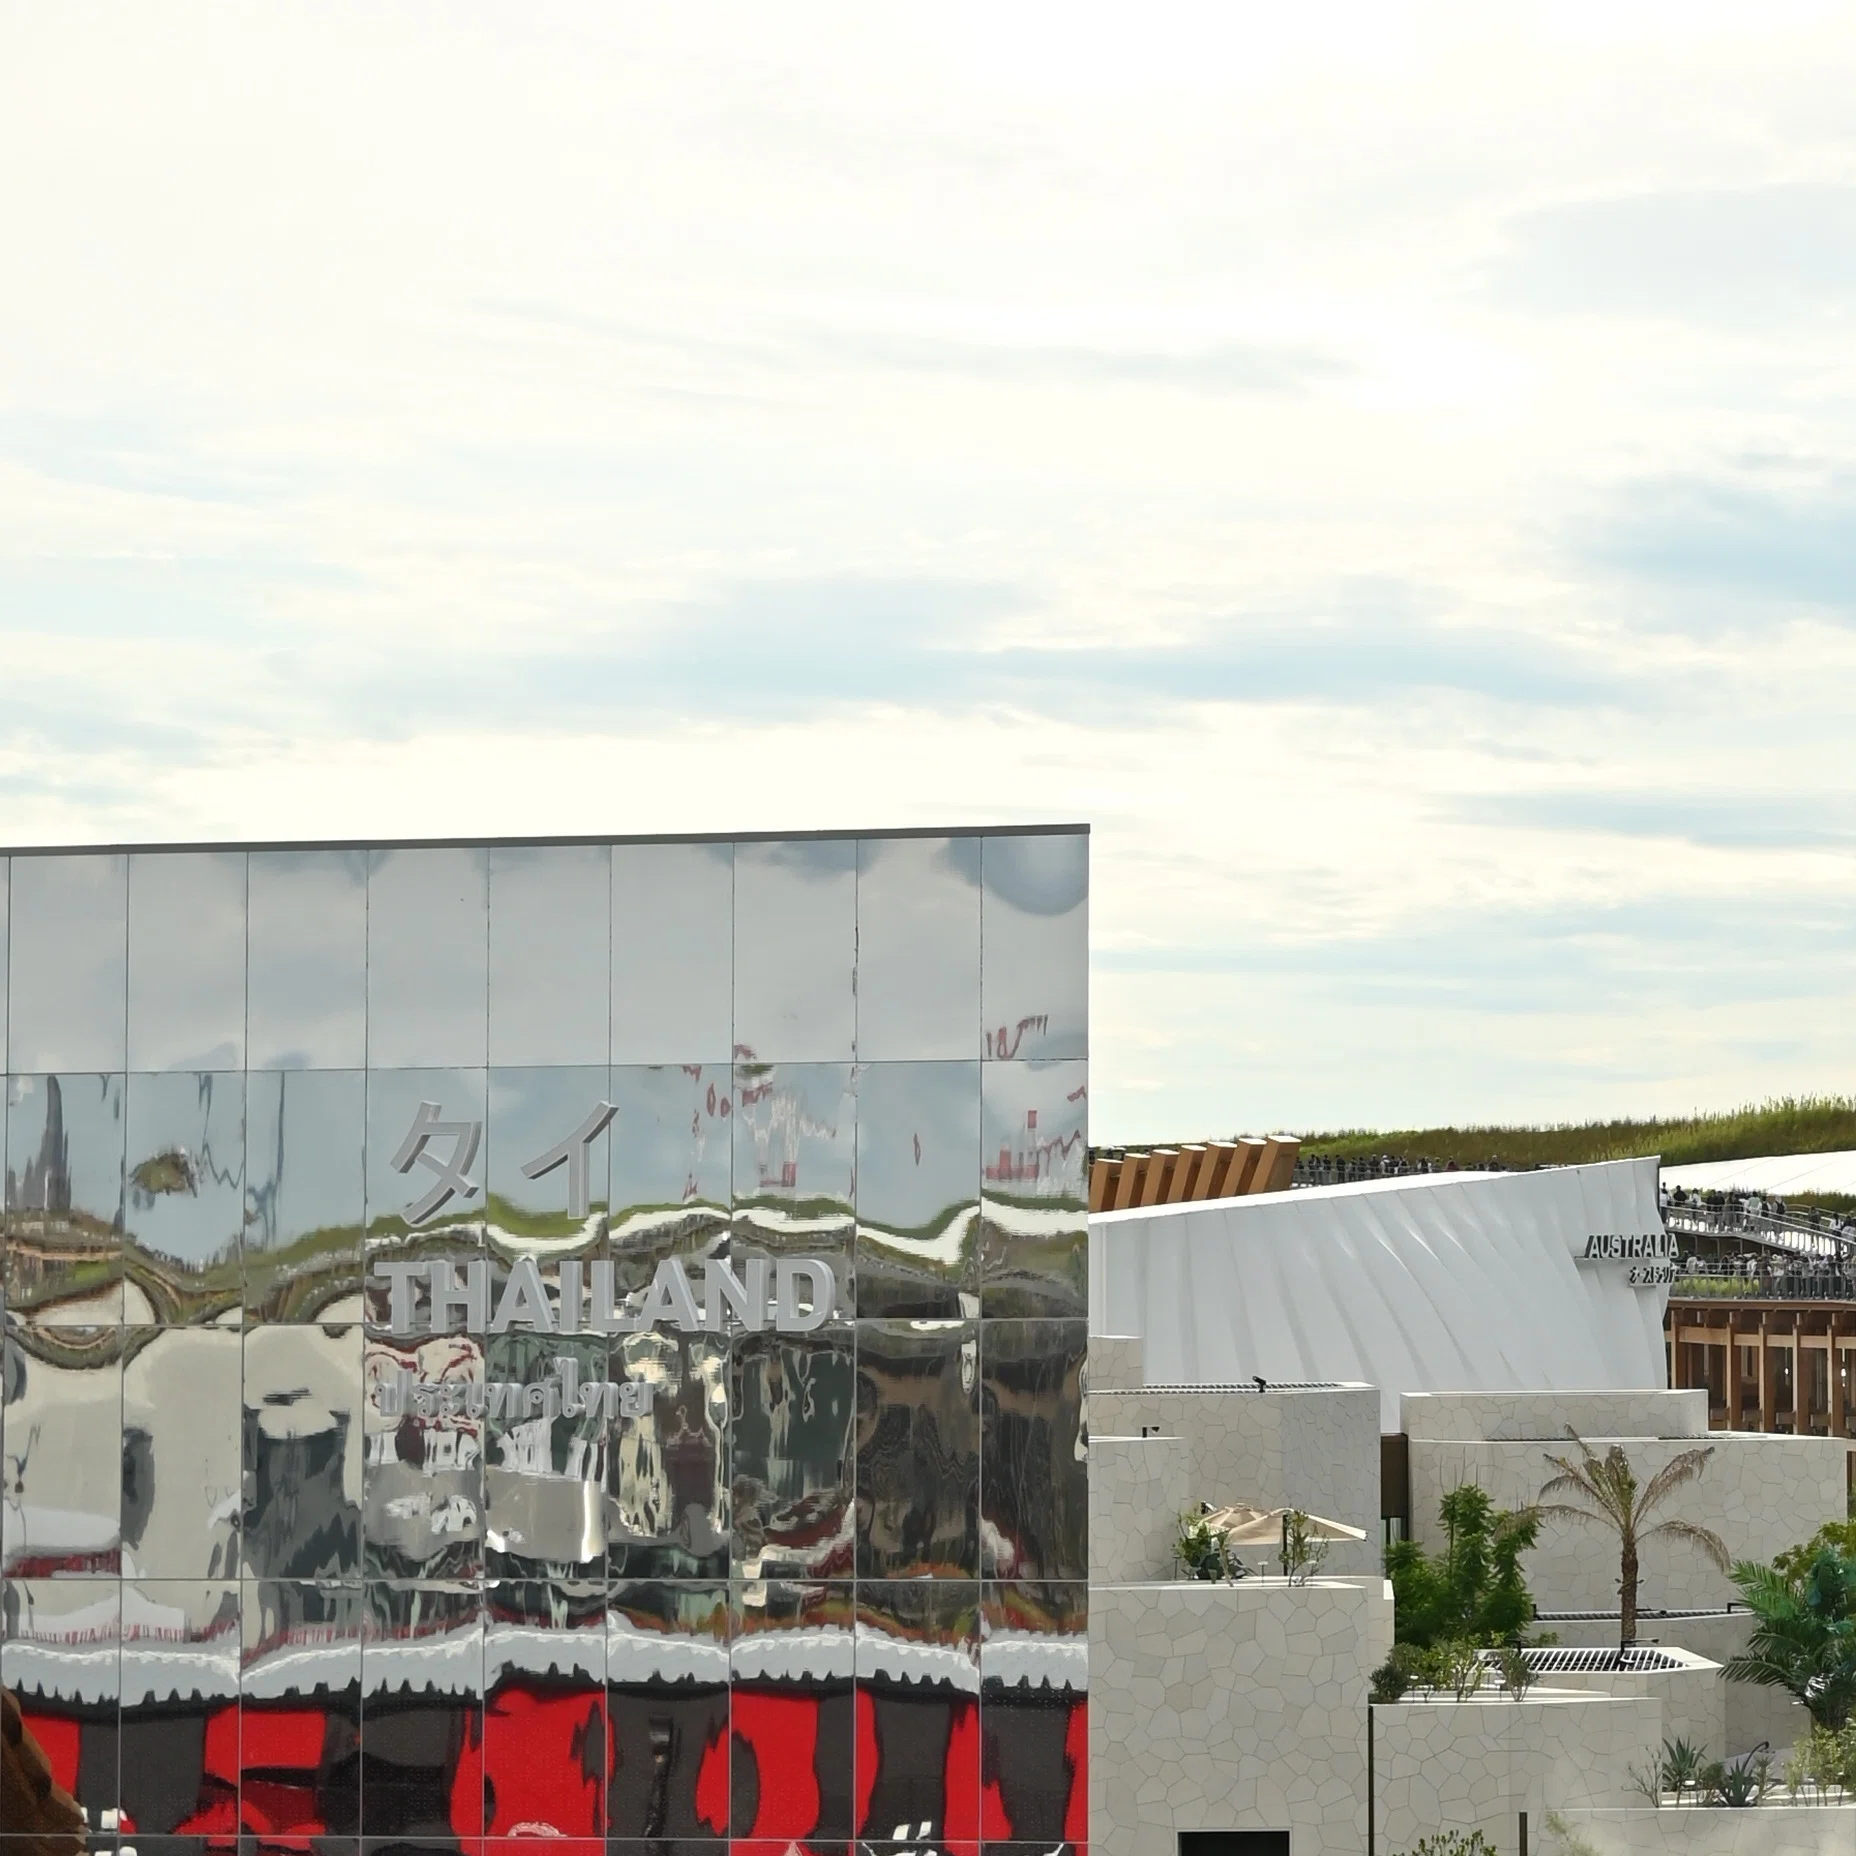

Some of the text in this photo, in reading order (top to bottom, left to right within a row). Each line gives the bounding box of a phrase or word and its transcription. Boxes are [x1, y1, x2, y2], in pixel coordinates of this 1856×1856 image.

[390, 1100, 619, 1227] タイ
[1586, 1233, 1679, 1259] AUSTRALIA
[374, 1257, 836, 1334] THAILAND
[375, 1356, 656, 1420] ประเทศไทย
